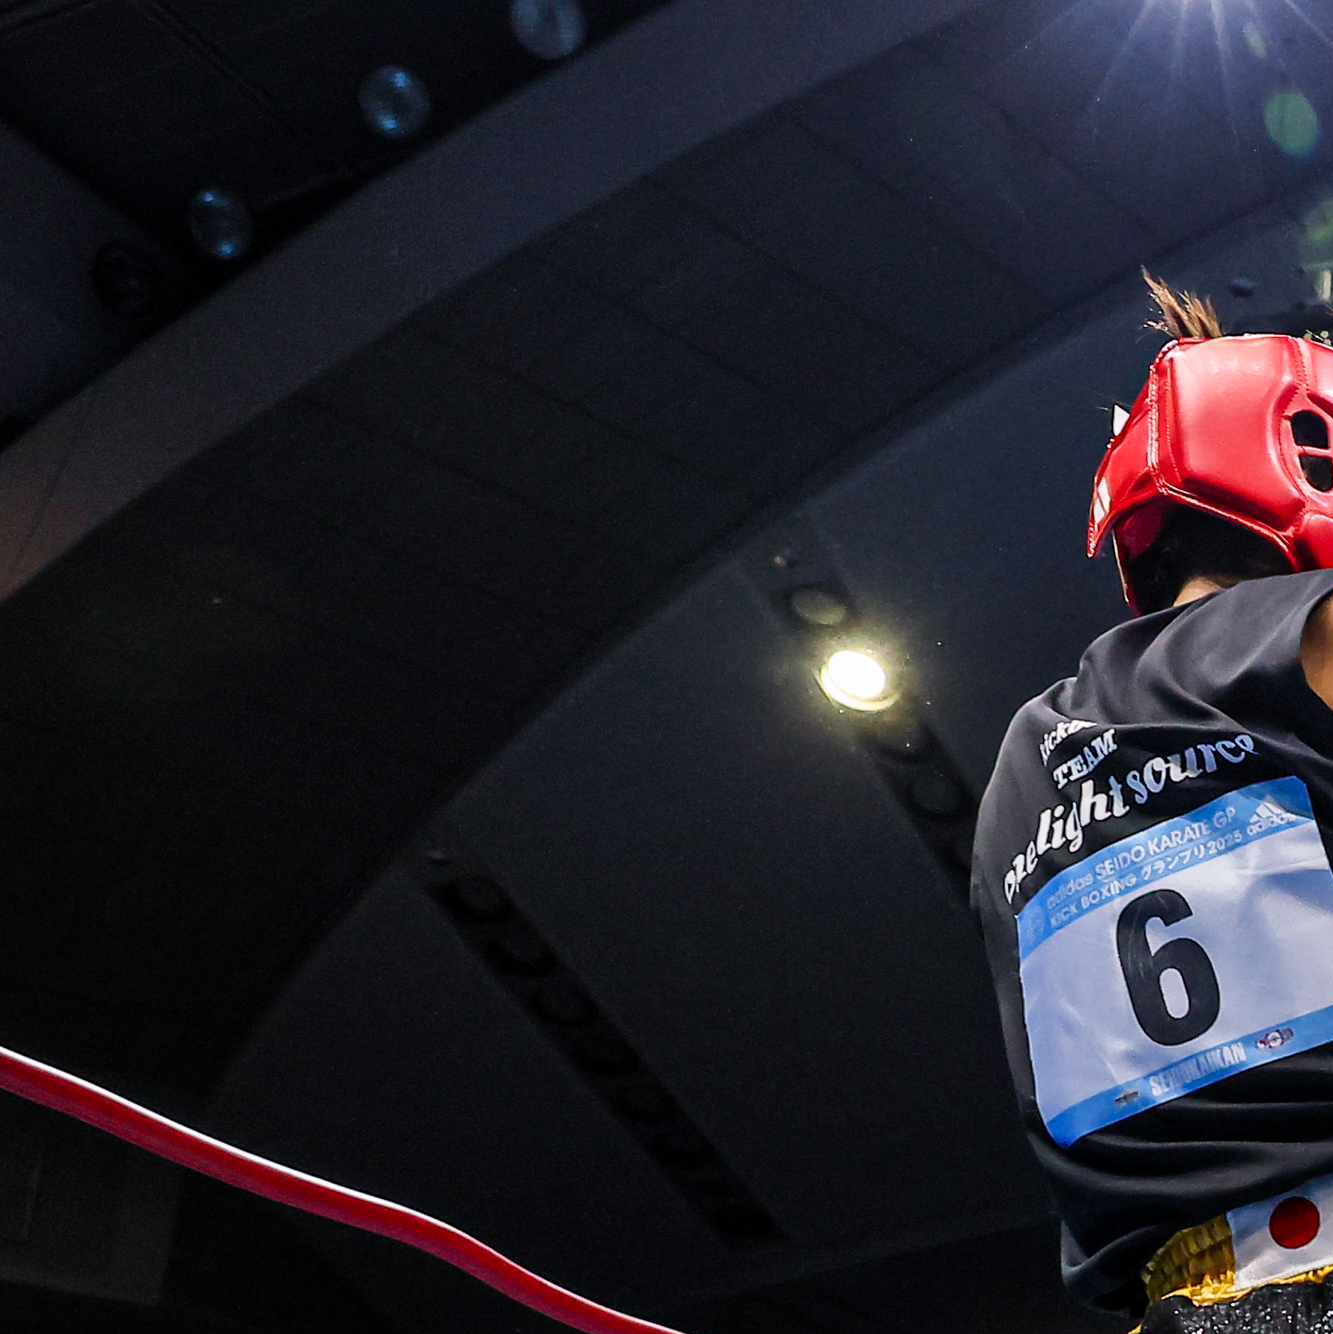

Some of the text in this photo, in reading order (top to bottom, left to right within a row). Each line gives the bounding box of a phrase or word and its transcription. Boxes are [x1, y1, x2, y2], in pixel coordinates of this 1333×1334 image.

[1053, 728, 1118, 790] TEAM
[1095, 845, 1146, 879] SEIDO
[1148, 820, 1212, 856] KARATE
[1213, 806, 1237, 829] GP
[1080, 874, 1138, 911] BOXING
[1115, 888, 1221, 1047] 6
